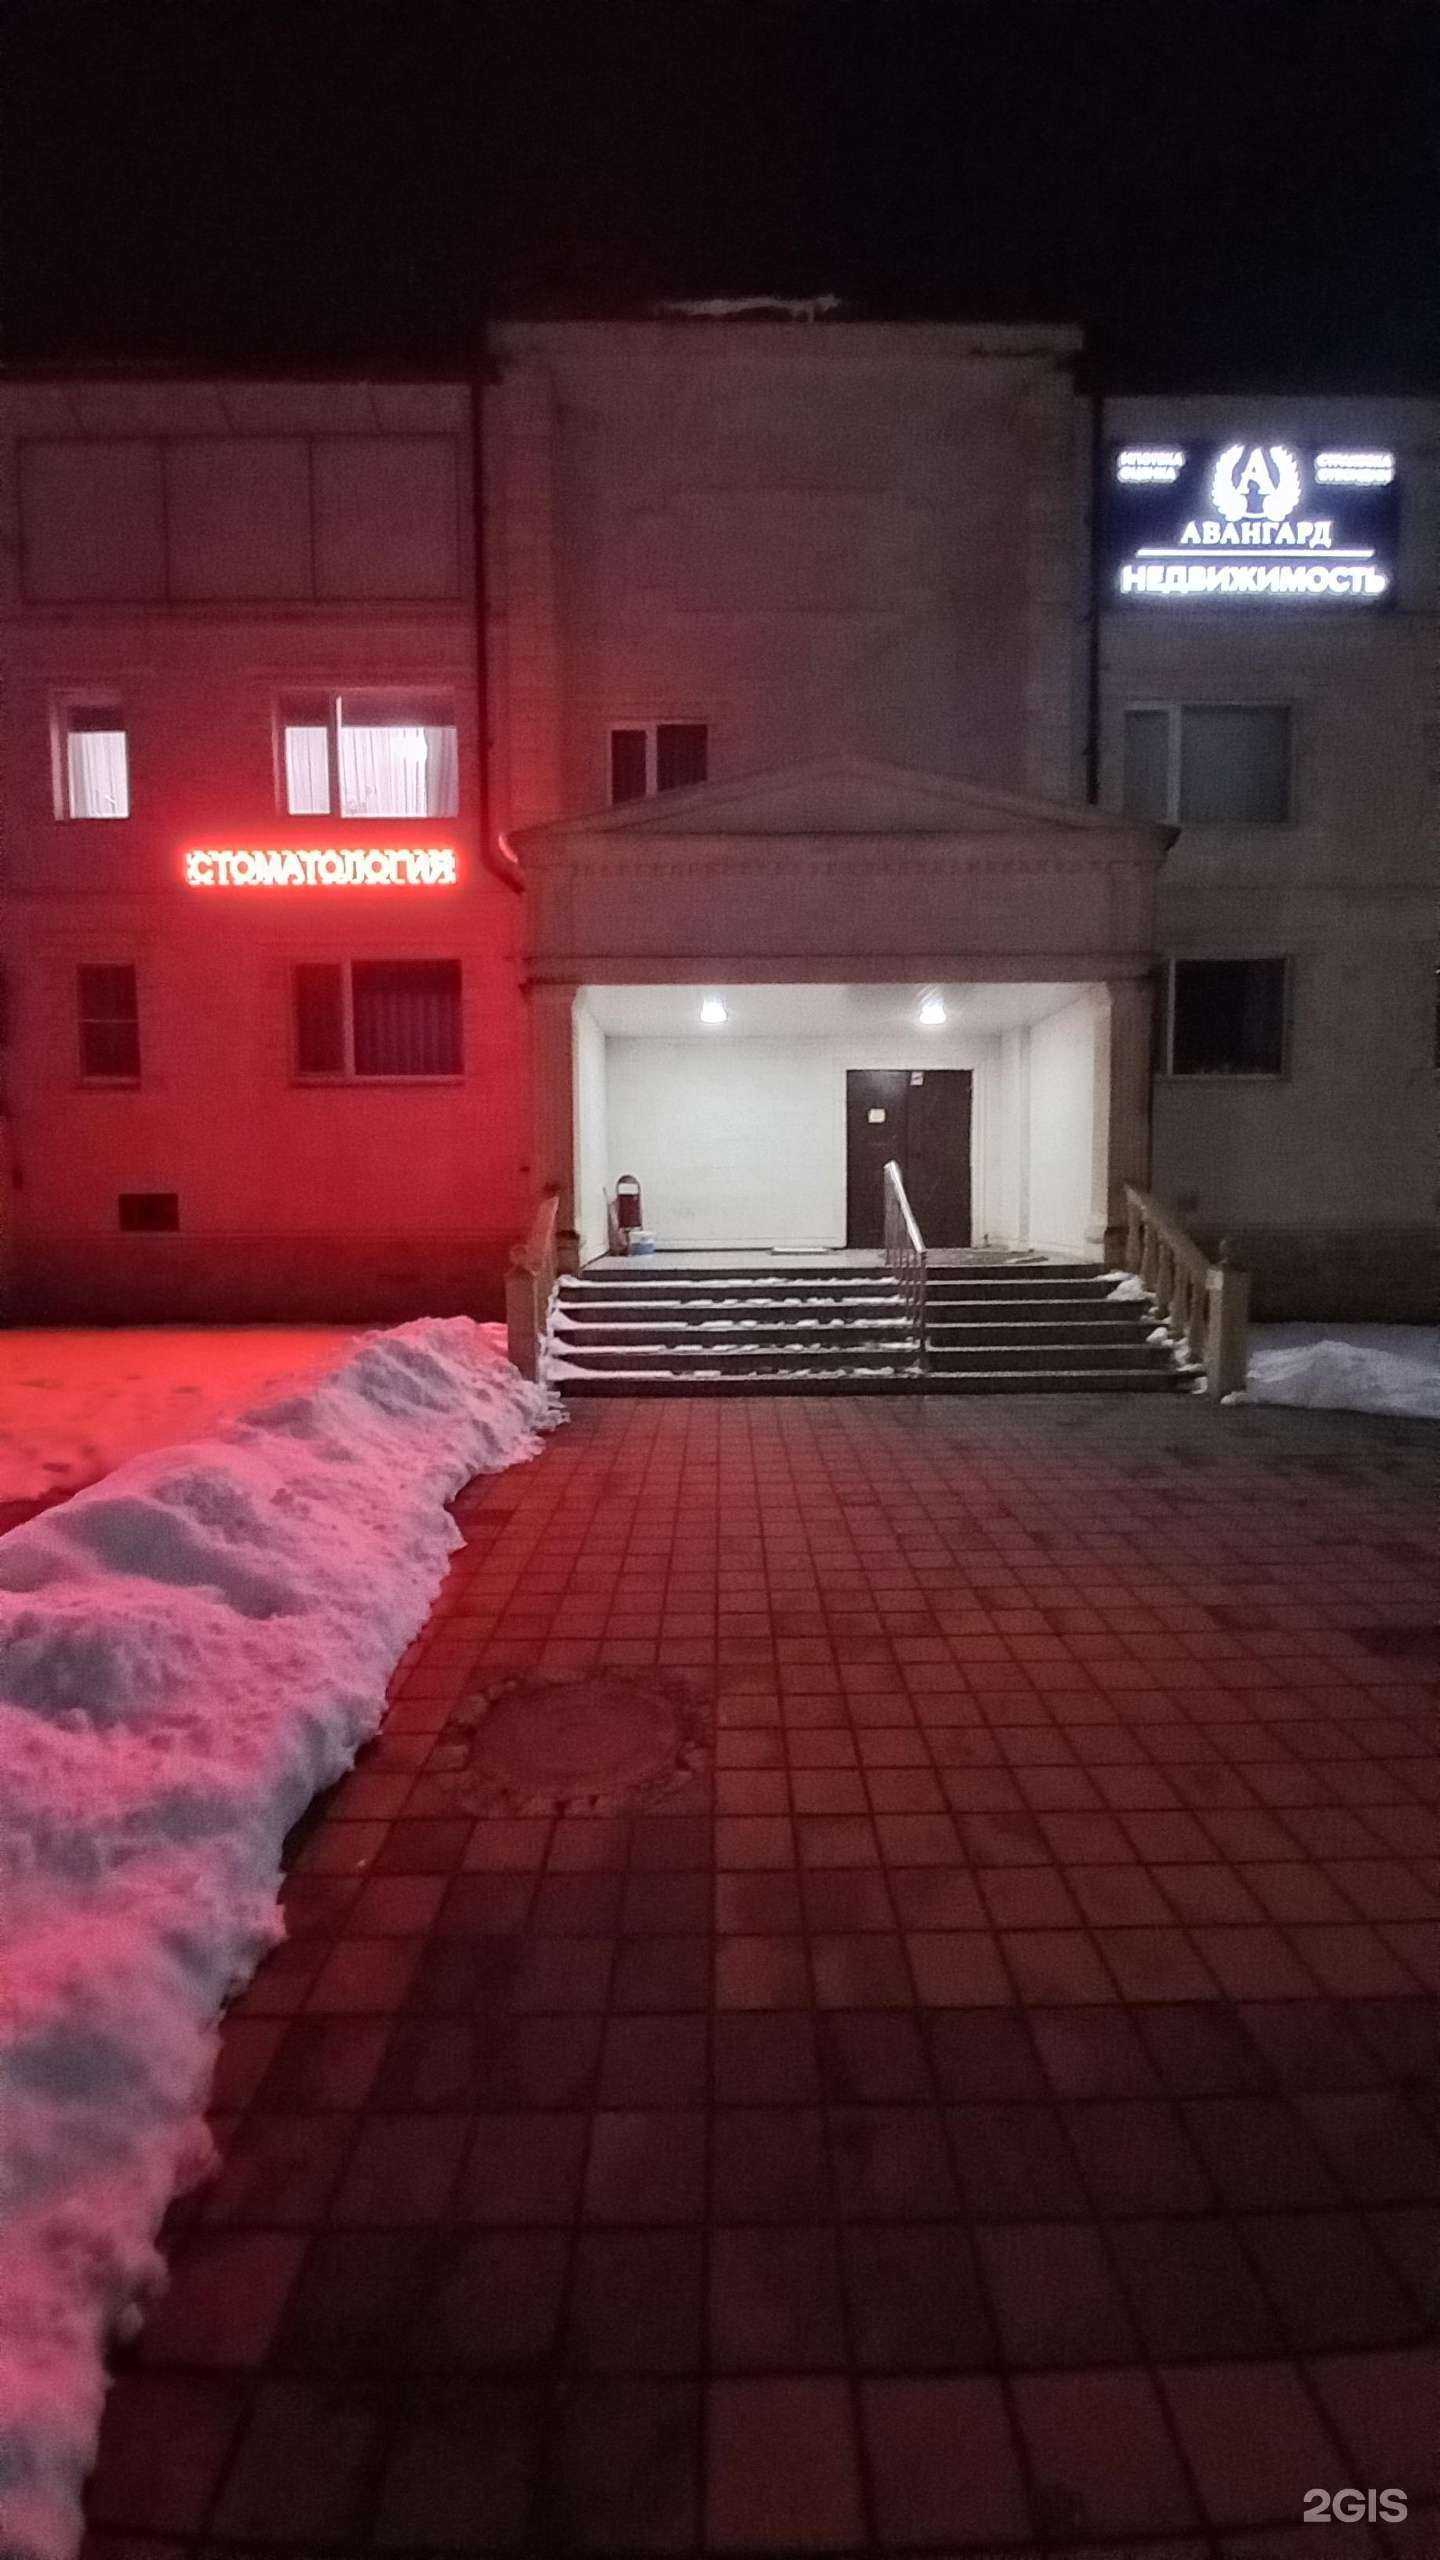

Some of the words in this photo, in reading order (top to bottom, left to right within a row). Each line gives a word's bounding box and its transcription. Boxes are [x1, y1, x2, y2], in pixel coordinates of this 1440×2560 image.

[1180, 521, 1332, 548] АВАНГАРД
[1120, 565, 1386, 595] НЕДВИЖИМОСТЬ
[187, 849, 457, 885] СТОМАТОЛОГИЯ
